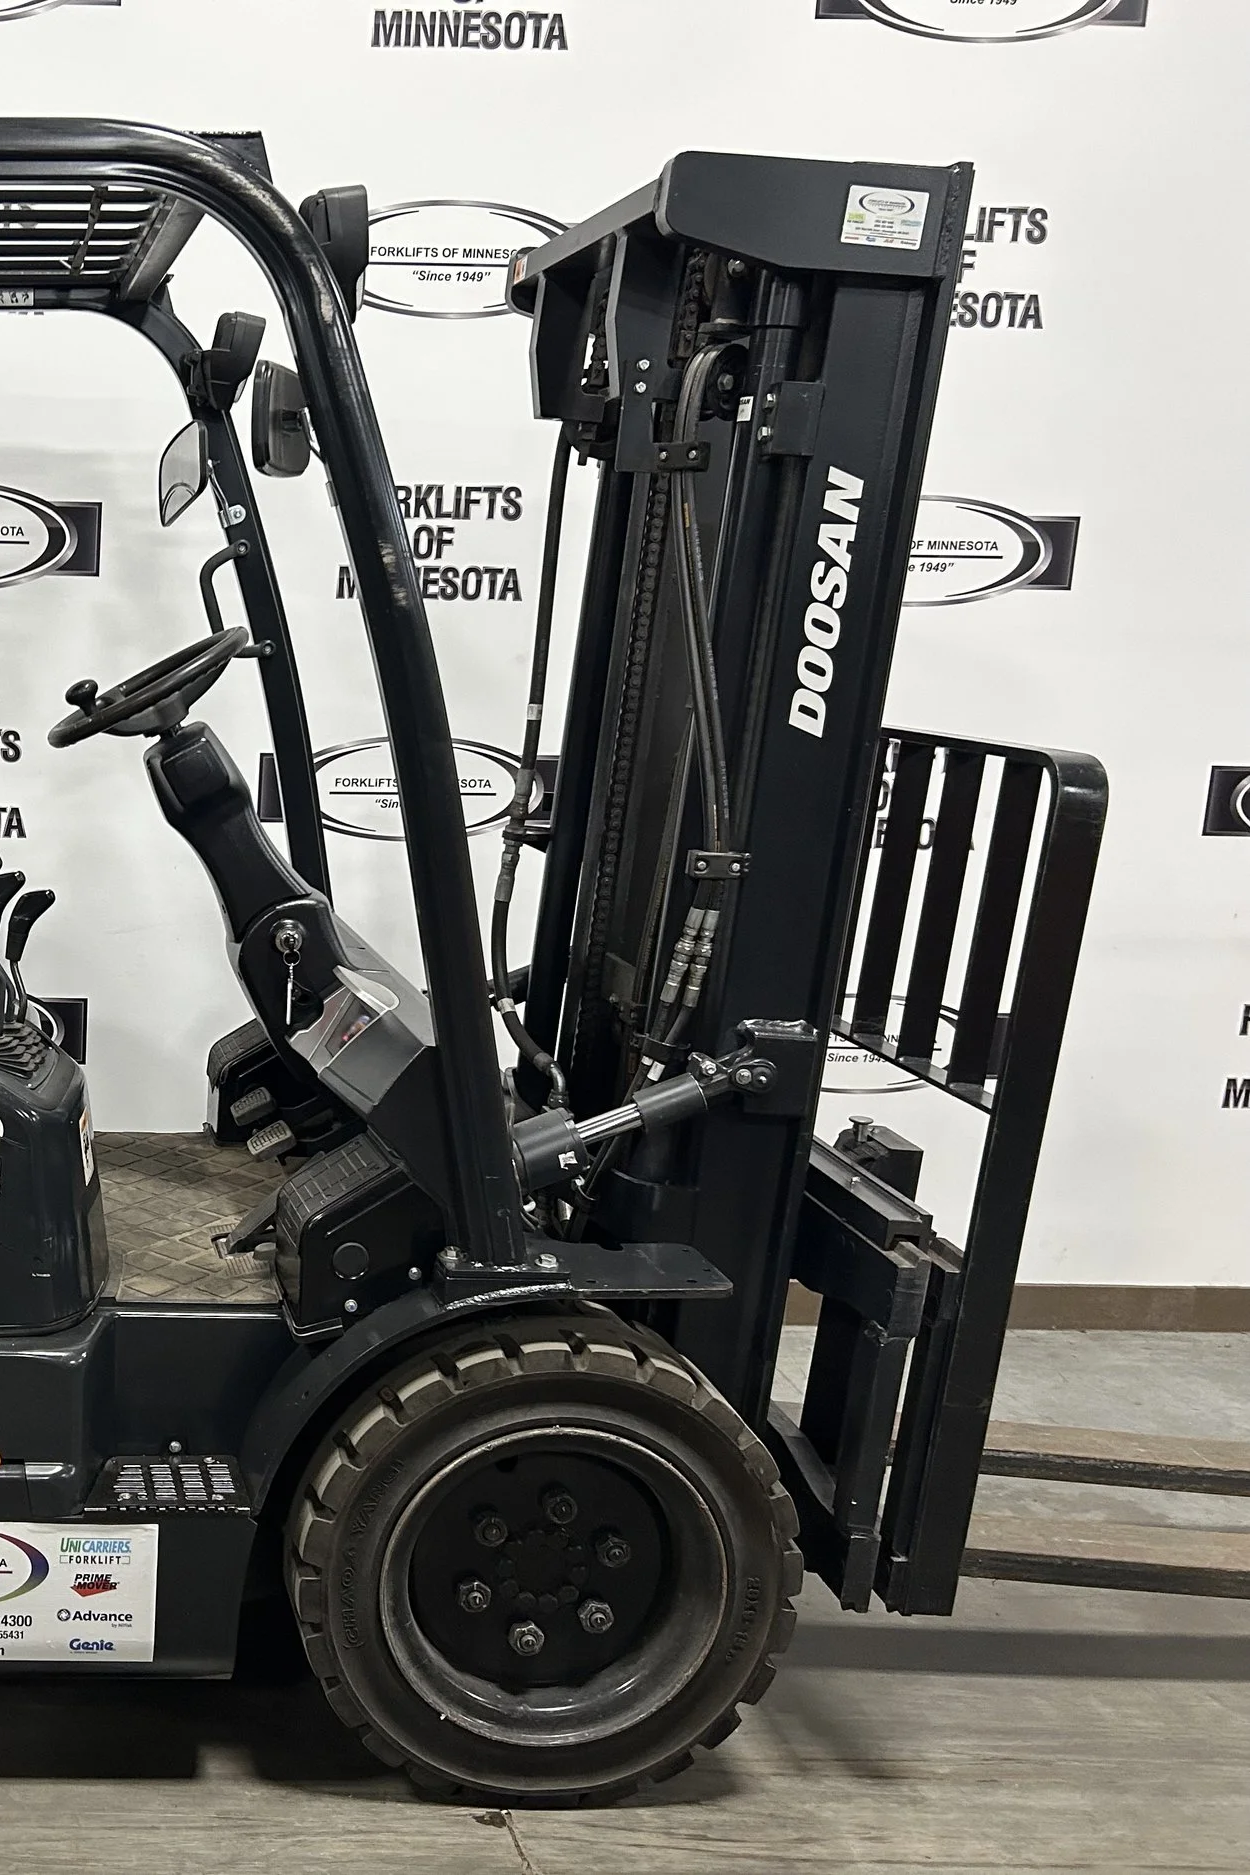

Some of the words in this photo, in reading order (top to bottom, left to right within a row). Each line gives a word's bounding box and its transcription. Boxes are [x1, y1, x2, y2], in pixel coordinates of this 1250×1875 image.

[371, 9, 568, 50] MINNESOTA
[371, 247, 438, 257] FORKLIFTS
[442, 248, 458, 258] OF
[461, 244, 517, 260] MINNES
[413, 271, 451, 281] “Since
[456, 272, 490, 282] 1949”
[395, 484, 524, 522] RKLIFTS
[413, 523, 456, 561] OF
[927, 541, 998, 550] MINNESOTA
[920, 562, 954, 572] 1949”
[336, 564, 522, 602] MESOTA
[789, 466, 864, 738] DOOSAN
[375, 799, 399, 809] “Sin
[68, 1556, 121, 1565] FORKLIFT
[74, 1573, 113, 1582] PRIME
[76, 1581, 118, 1590] MOVER
[72, 1610, 132, 1621] Advance
[69, 1638, 116, 1651] Genie
